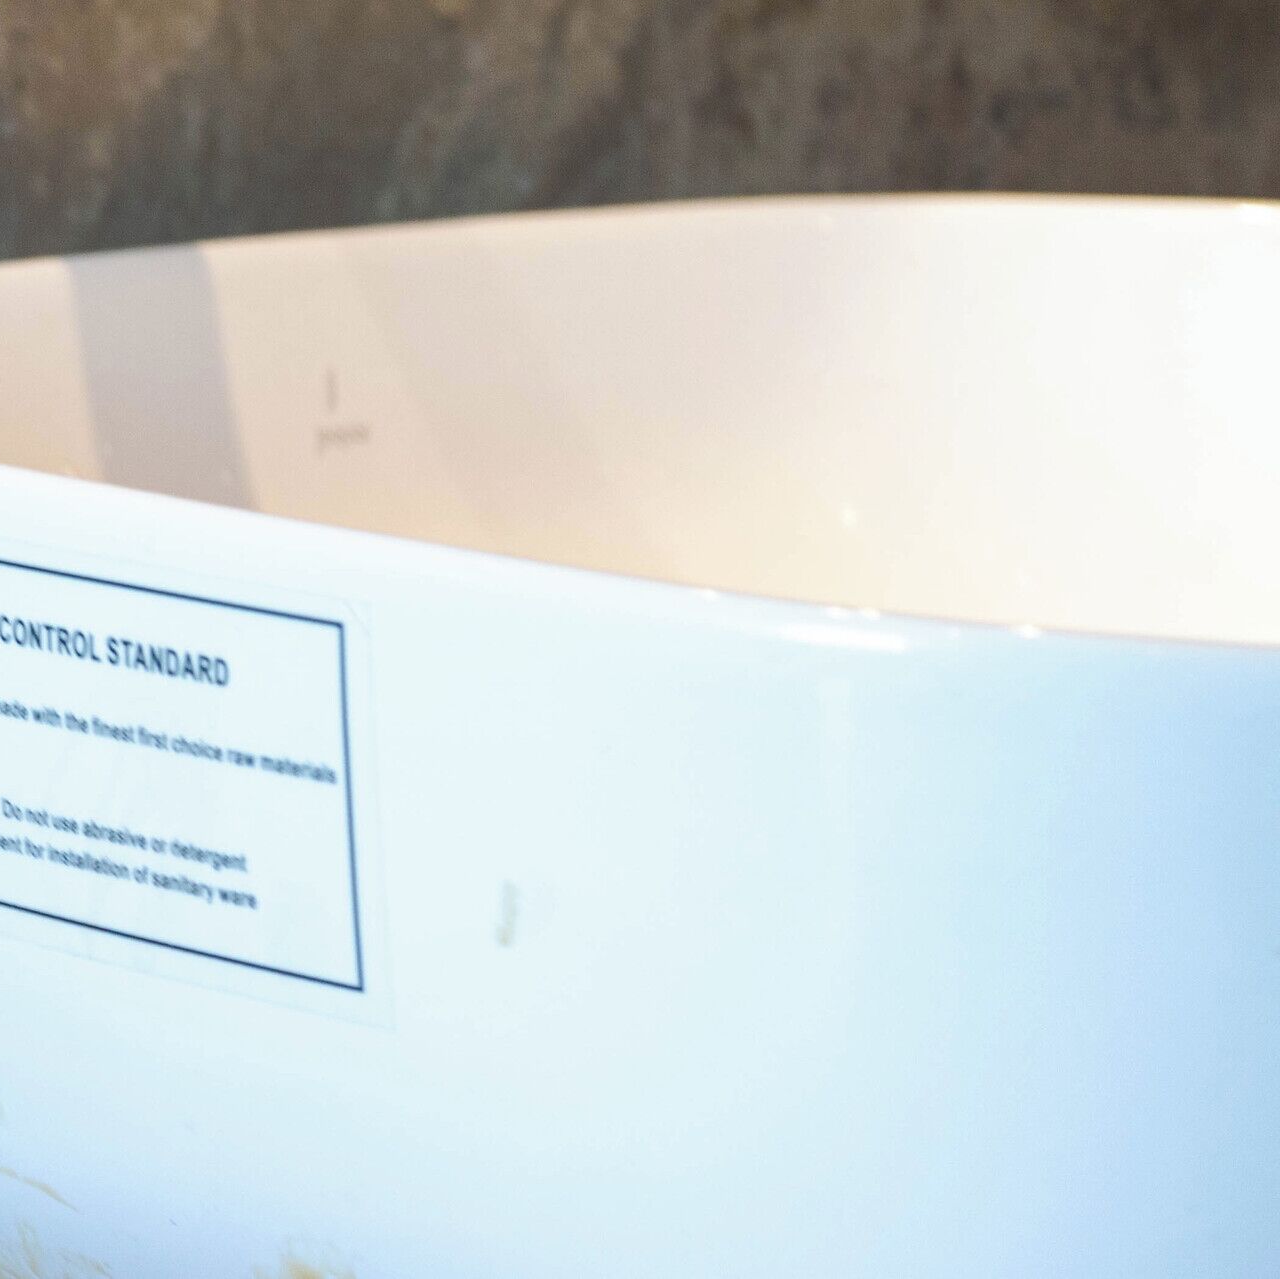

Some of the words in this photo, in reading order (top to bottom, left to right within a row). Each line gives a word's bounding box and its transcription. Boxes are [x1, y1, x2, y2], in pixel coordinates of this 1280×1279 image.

[107, 636, 230, 687] STANDARD
[32, 706, 61, 728] with
[65, 712, 88, 734] the
[92, 716, 135, 744] finest
[138, 725, 167, 750] first
[172, 735, 223, 762] choice
[227, 749, 255, 769] raw
[260, 755, 337, 785] materials
[1, 797, 23, 821] Do
[25, 808, 49, 828] not
[52, 814, 79, 834] use
[83, 818, 147, 851] abrasive
[151, 836, 167, 854] or
[170, 838, 247, 871] detergent
[24, 836, 44, 860] for
[46, 842, 130, 880] installation
[133, 865, 149, 884] of
[151, 871, 213, 904] sanitary
[218, 888, 257, 910] ware
